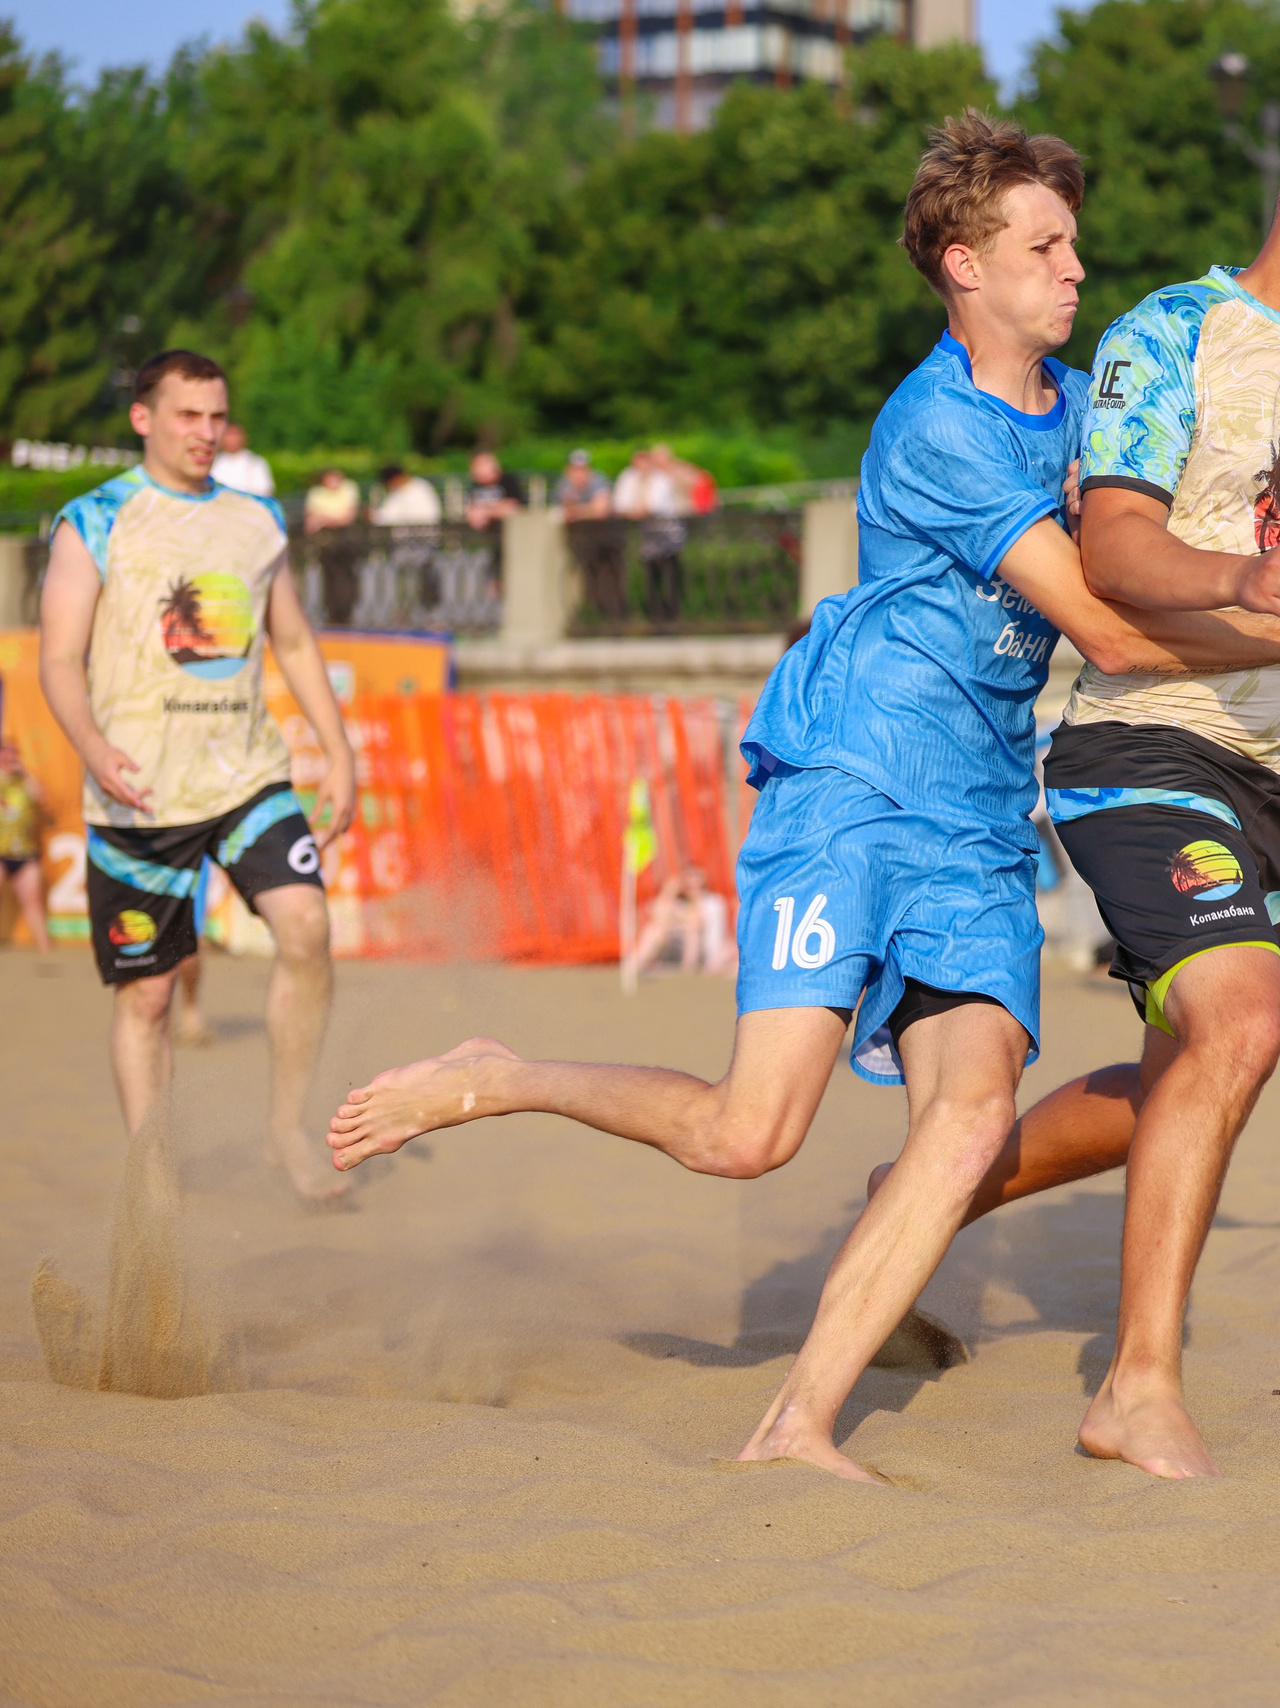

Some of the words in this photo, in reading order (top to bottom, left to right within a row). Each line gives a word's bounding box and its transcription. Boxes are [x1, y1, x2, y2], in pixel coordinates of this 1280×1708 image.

[993, 620, 1052, 663] банк
[287, 833, 319, 875] 6
[771, 893, 837, 971] 16
[1189, 904, 1256, 927] Копакабана
